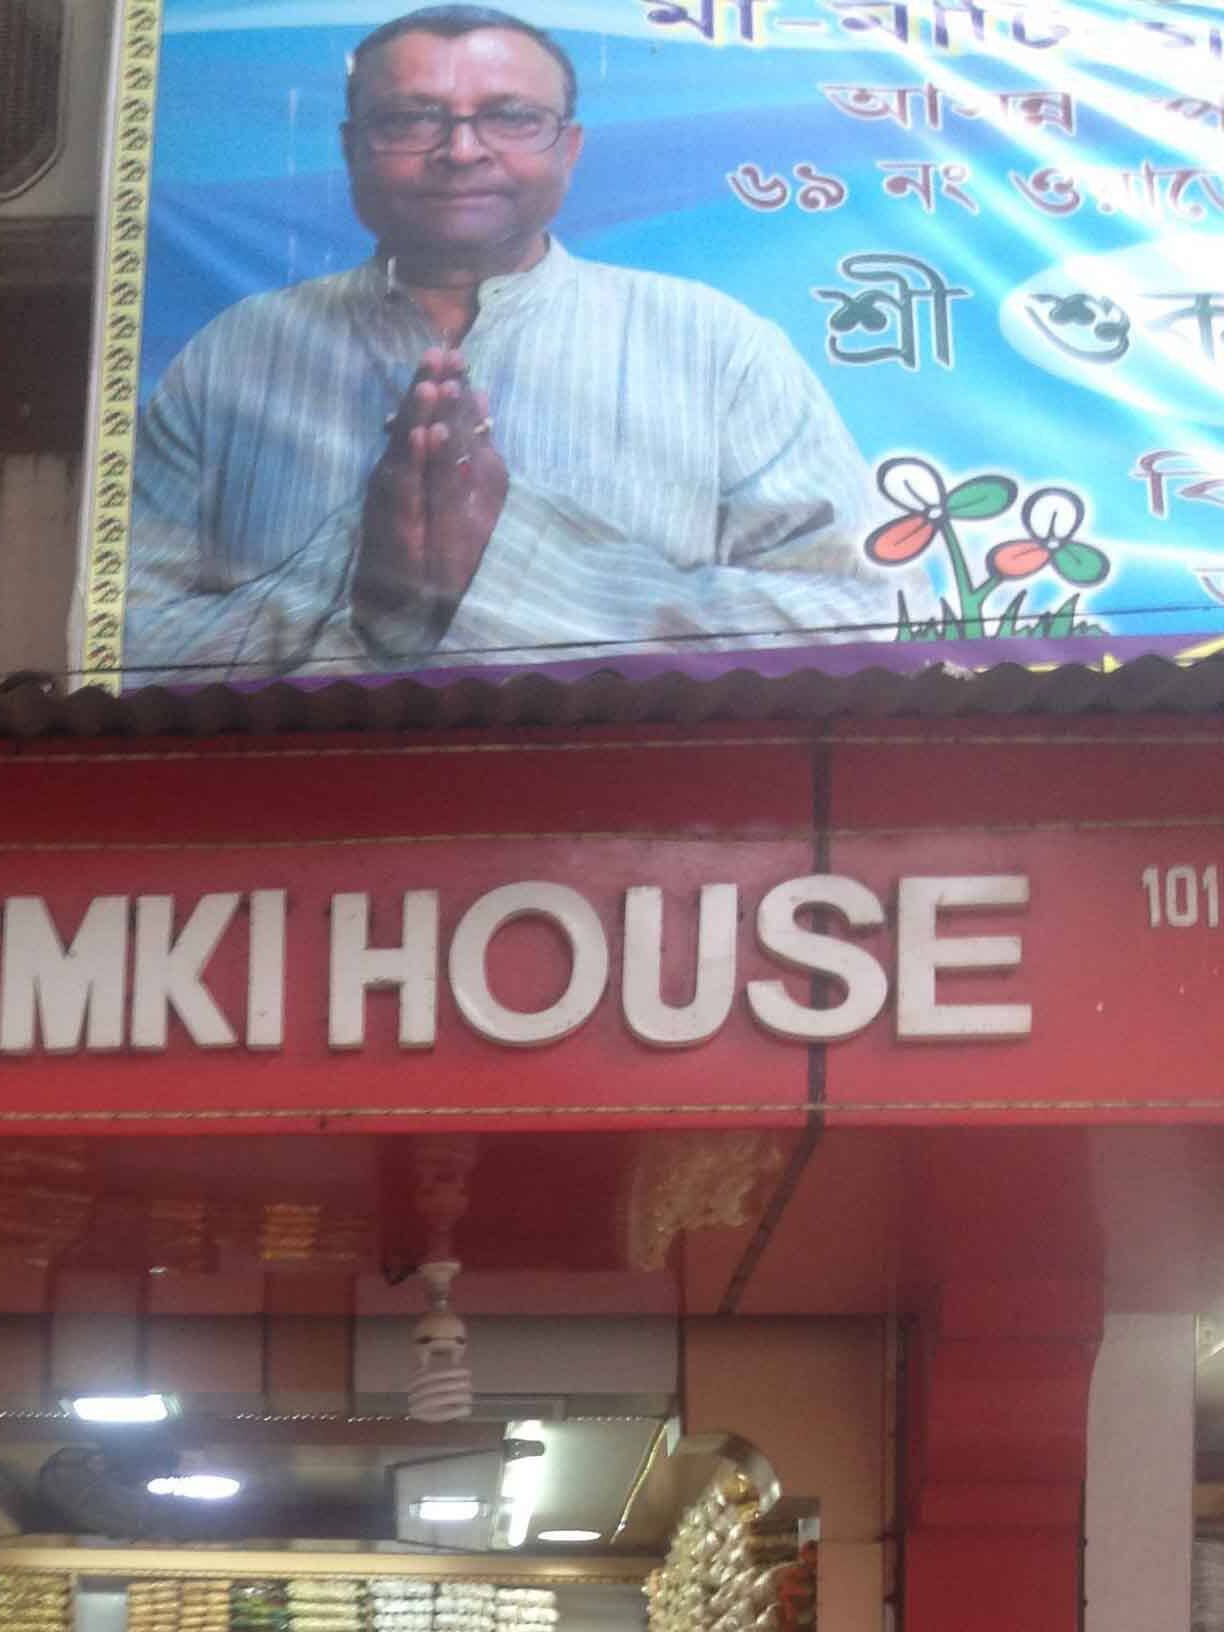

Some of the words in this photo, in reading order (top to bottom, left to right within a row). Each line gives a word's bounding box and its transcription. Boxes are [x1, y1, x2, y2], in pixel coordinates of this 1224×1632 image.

[728, 164, 846, 213] ৬৯
[878, 162, 979, 212] নং
[814, 253, 971, 369] শ্রী
[328, 874, 1033, 1052] HOUSE
